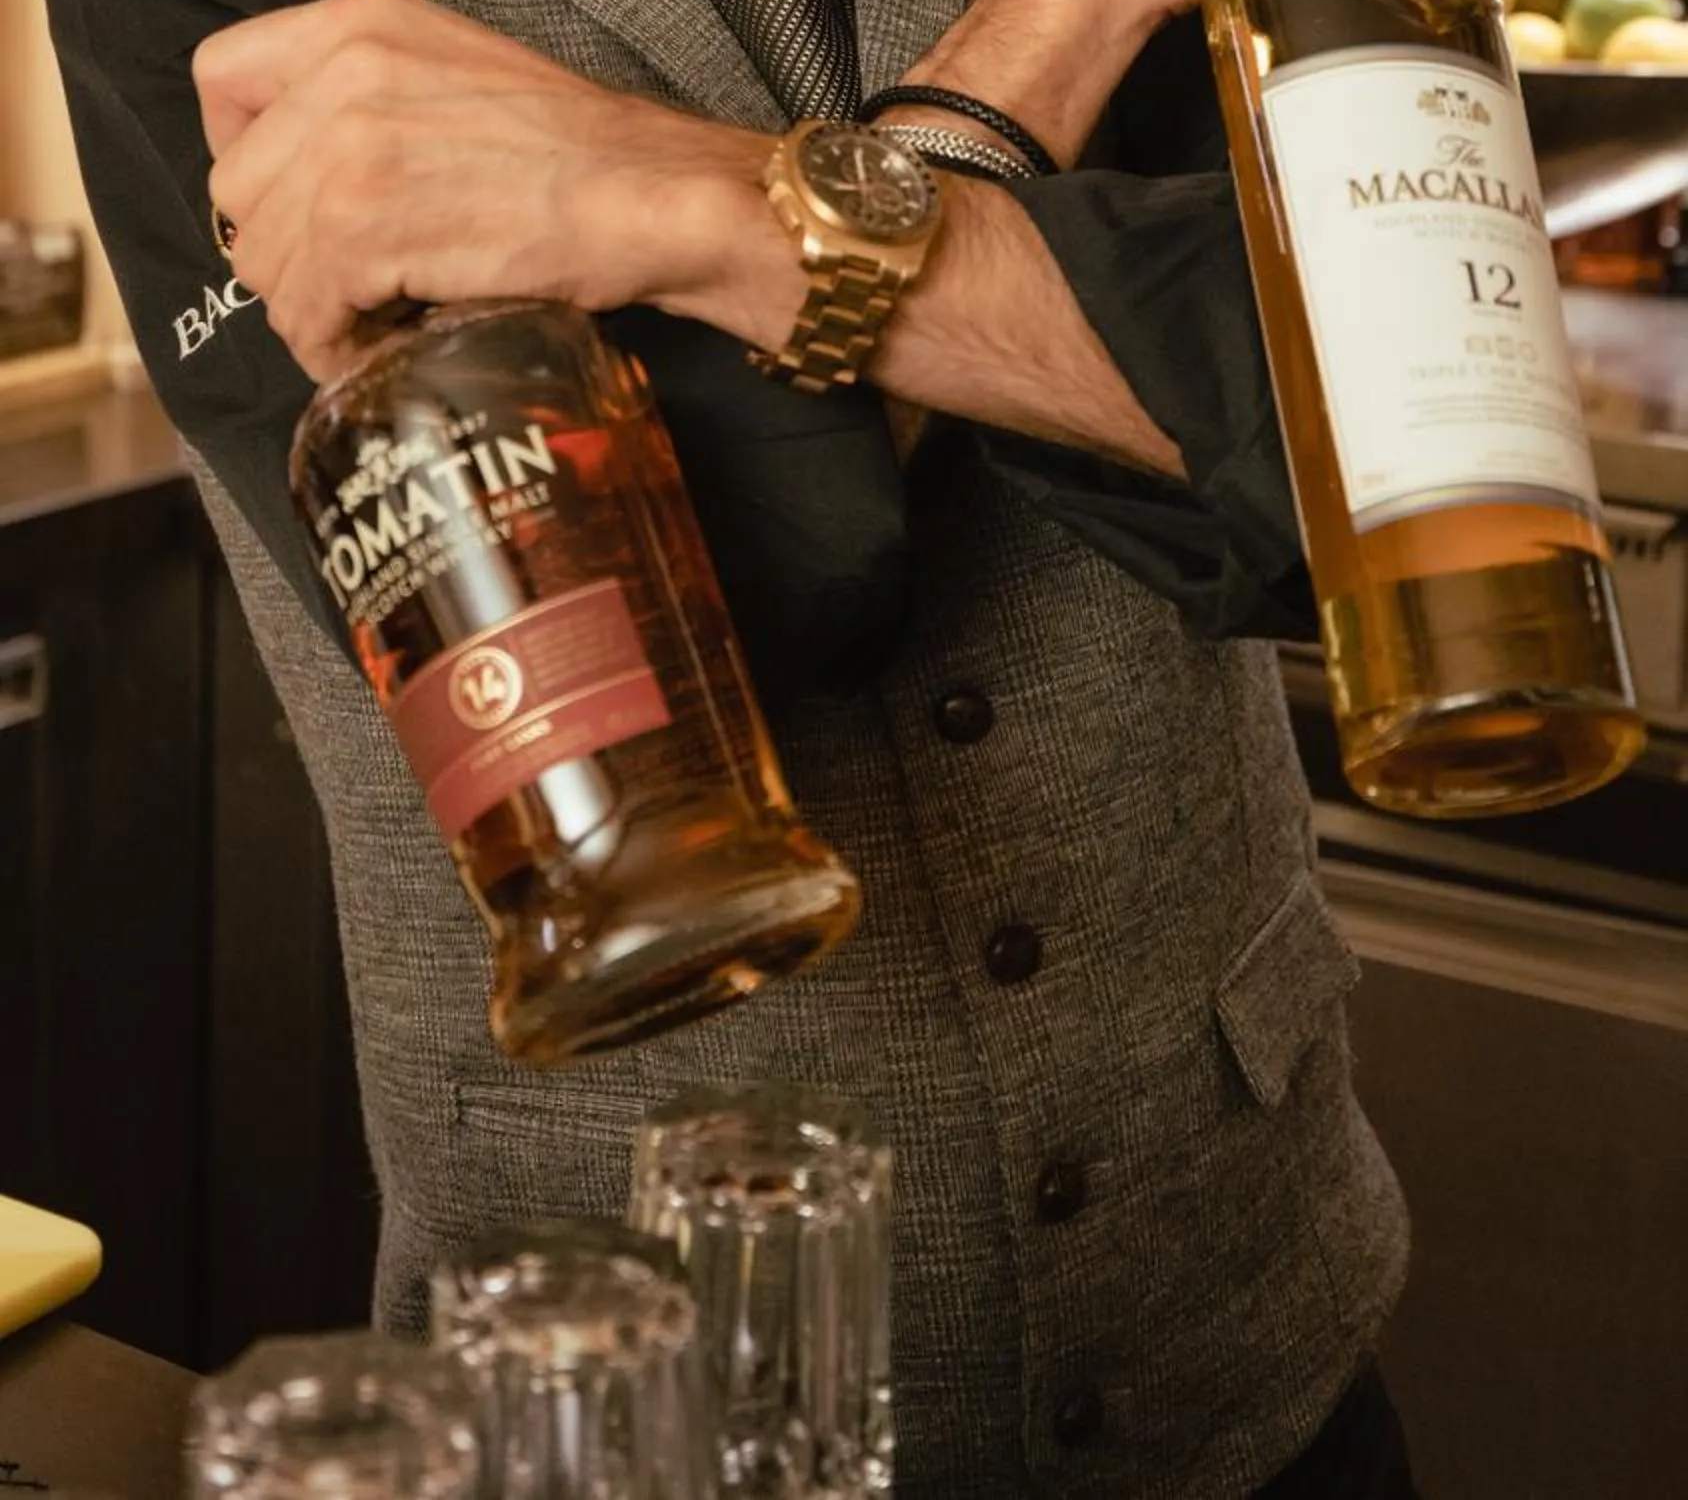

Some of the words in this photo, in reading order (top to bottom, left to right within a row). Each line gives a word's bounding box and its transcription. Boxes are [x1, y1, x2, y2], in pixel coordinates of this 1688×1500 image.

[1436, 134, 1485, 168] The
[1460, 260, 1522, 309] 12
[322, 424, 556, 610] TOMATIN
[461, 665, 506, 711] 14
